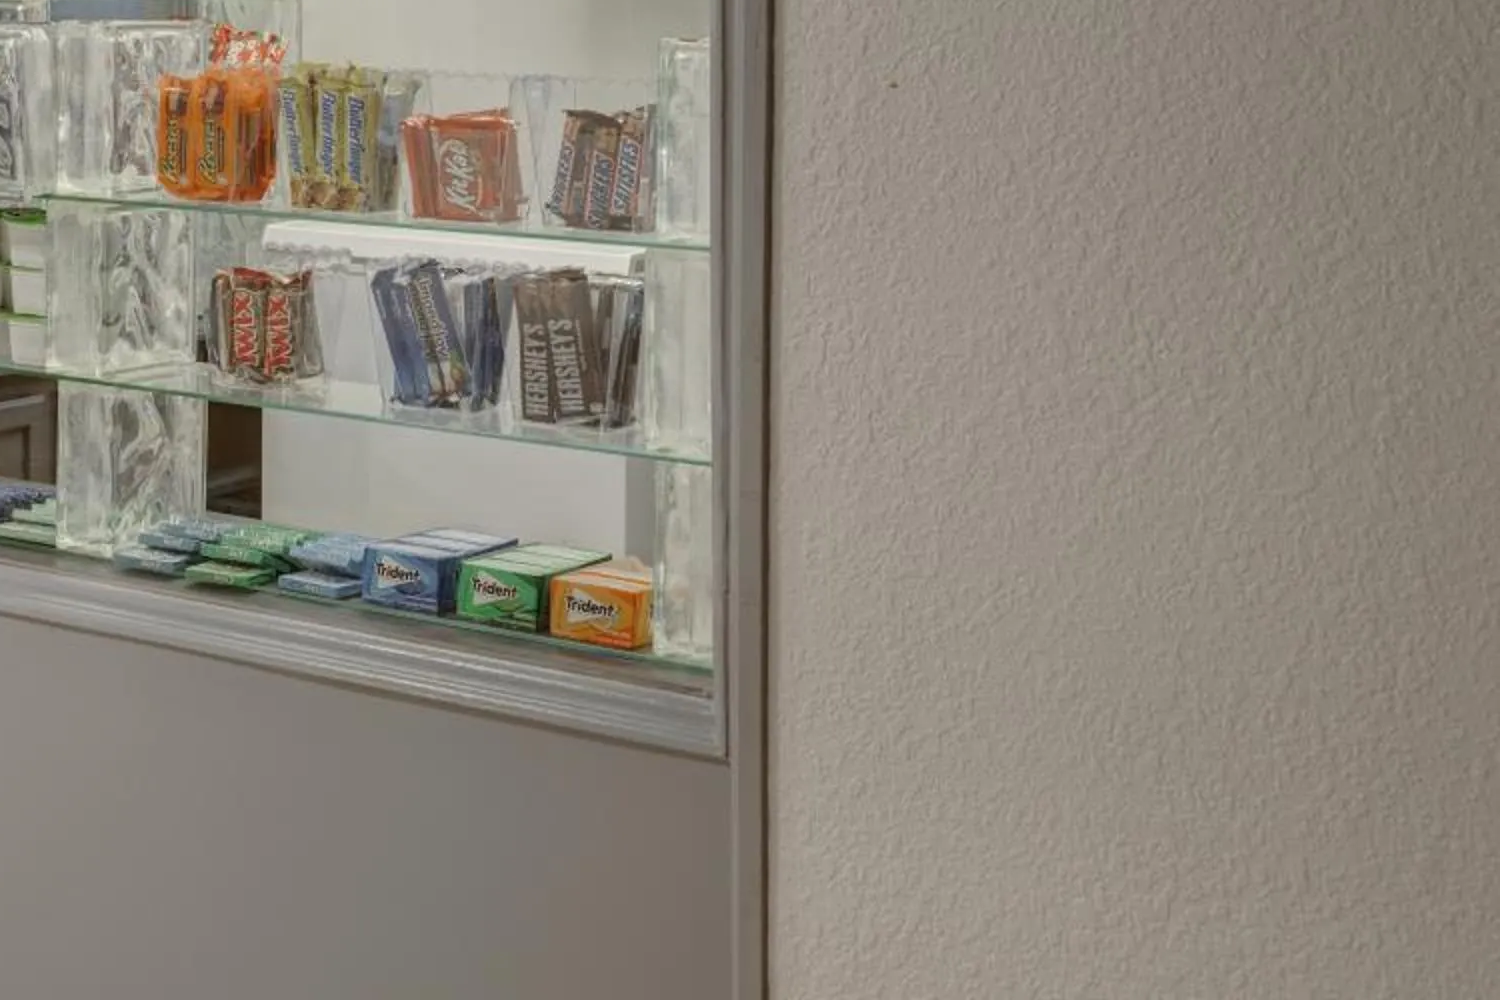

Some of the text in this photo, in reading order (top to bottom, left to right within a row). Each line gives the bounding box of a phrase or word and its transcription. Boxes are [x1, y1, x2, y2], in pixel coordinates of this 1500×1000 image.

[375, 562, 421, 585] Trident
[471, 577, 519, 599] Trident
[564, 594, 617, 617] Trident
